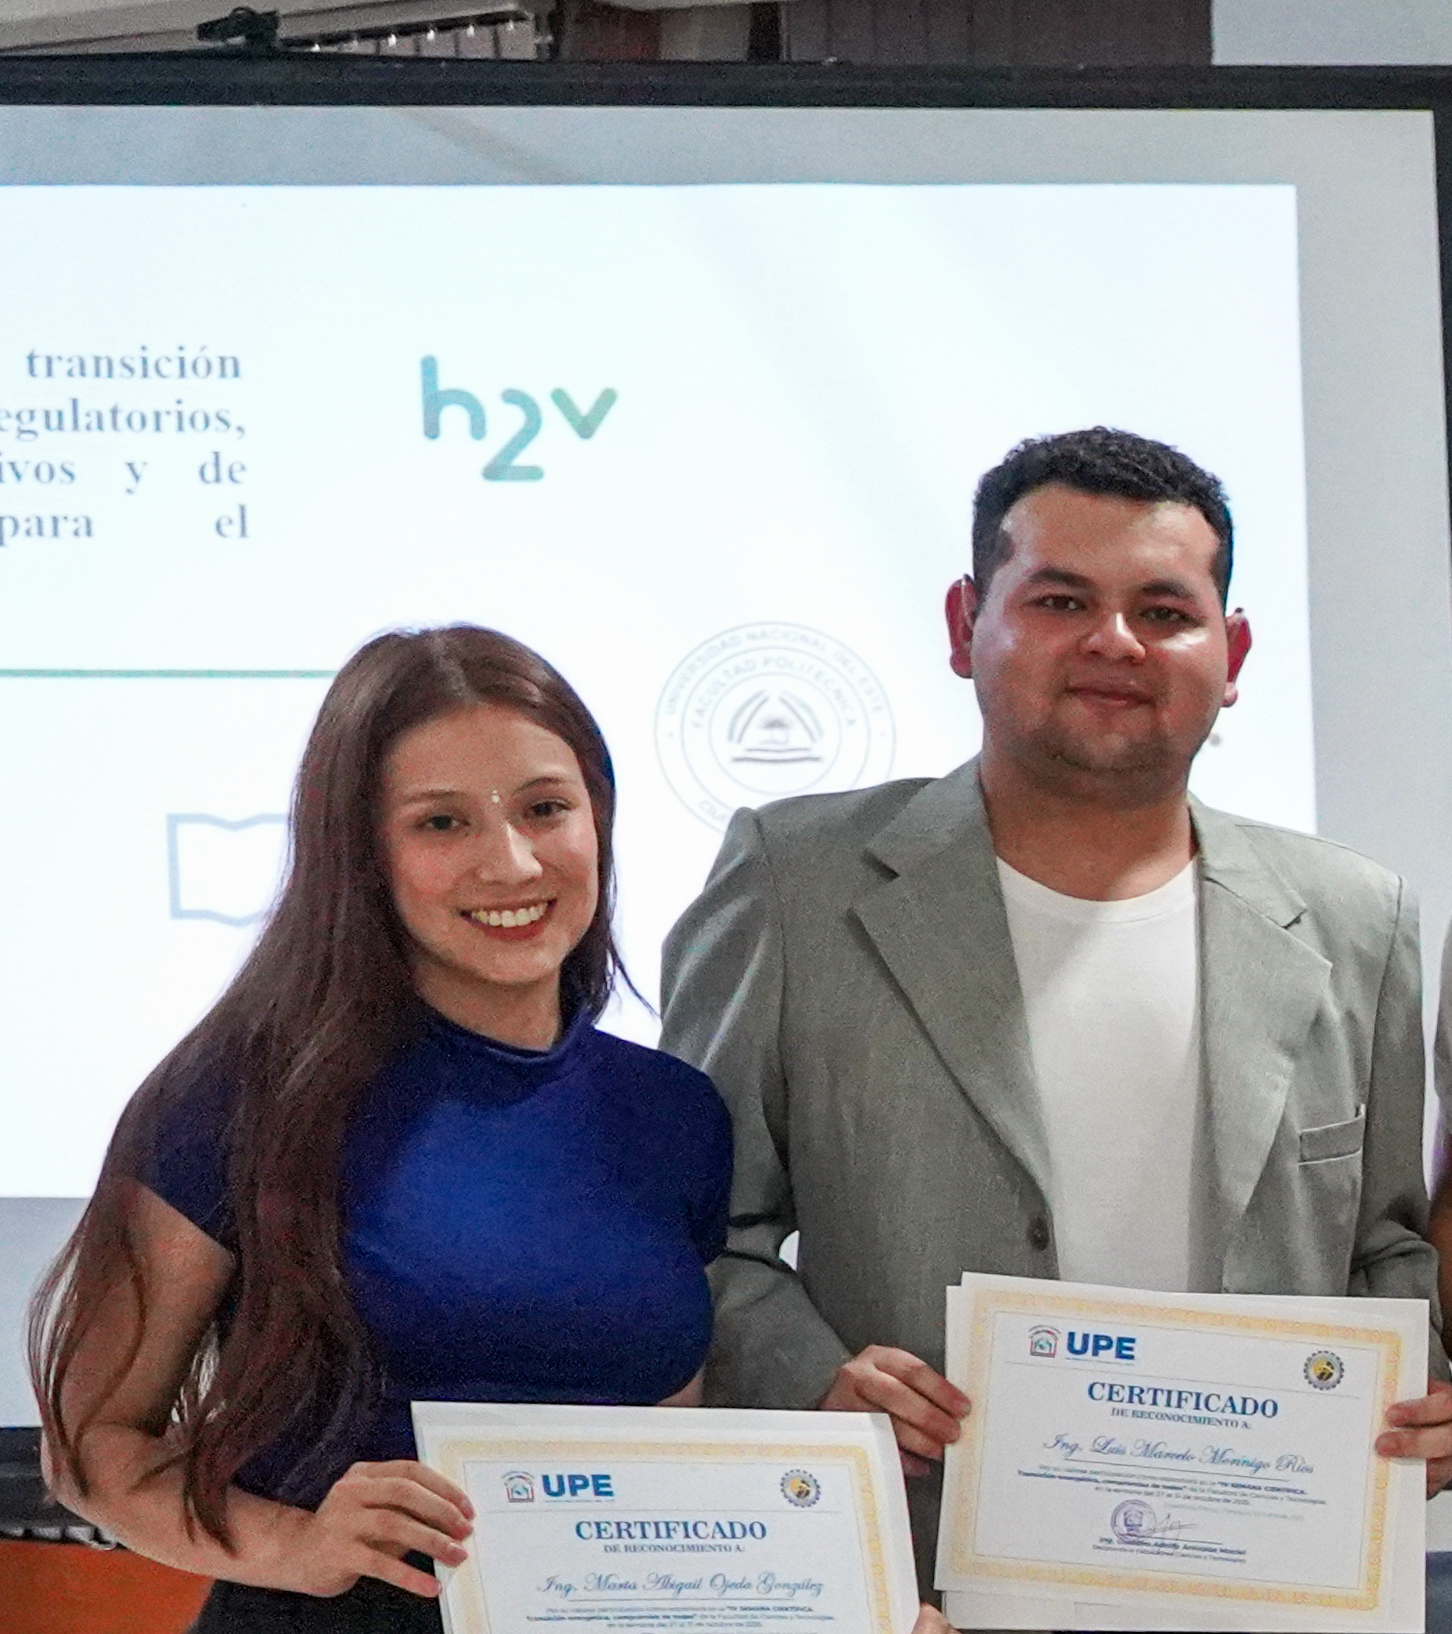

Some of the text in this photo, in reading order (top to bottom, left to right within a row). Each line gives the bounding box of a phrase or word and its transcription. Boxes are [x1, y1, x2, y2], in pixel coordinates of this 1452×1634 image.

[26, 345, 242, 379] transición
[125, 462, 147, 494] y
[199, 451, 246, 484] de
[0, 504, 248, 547] para el
[1066, 1331, 1136, 1360] UPE
[1088, 1382, 1278, 1418] CERTIFICADO
[1111, 1408, 1128, 1418] DE
[542, 1474, 615, 1497] UPE
[575, 1520, 767, 1540] CERTIFICADO
[603, 1544, 621, 1553] DE
